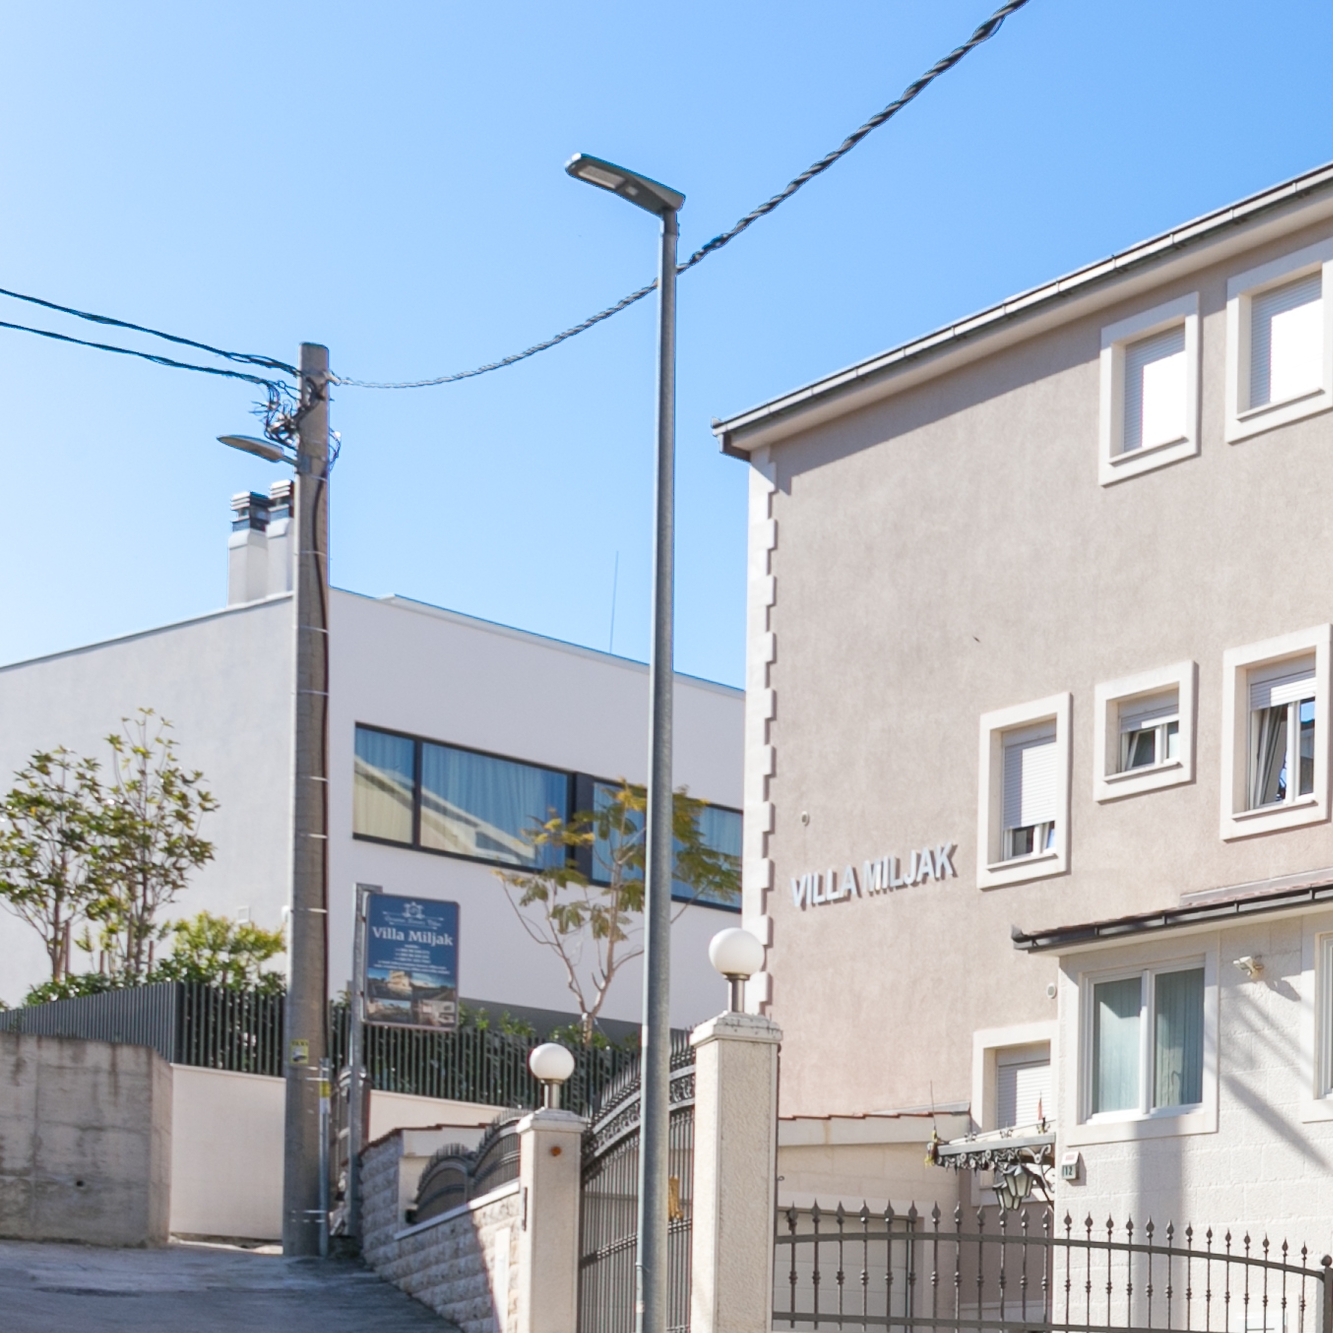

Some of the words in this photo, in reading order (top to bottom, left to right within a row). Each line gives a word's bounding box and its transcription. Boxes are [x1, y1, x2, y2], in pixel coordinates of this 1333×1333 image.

[790, 864, 857, 907] VILLA
[862, 842, 953, 892] MILJAK
[372, 926, 405, 941] Villa
[408, 930, 453, 947] Miljak
